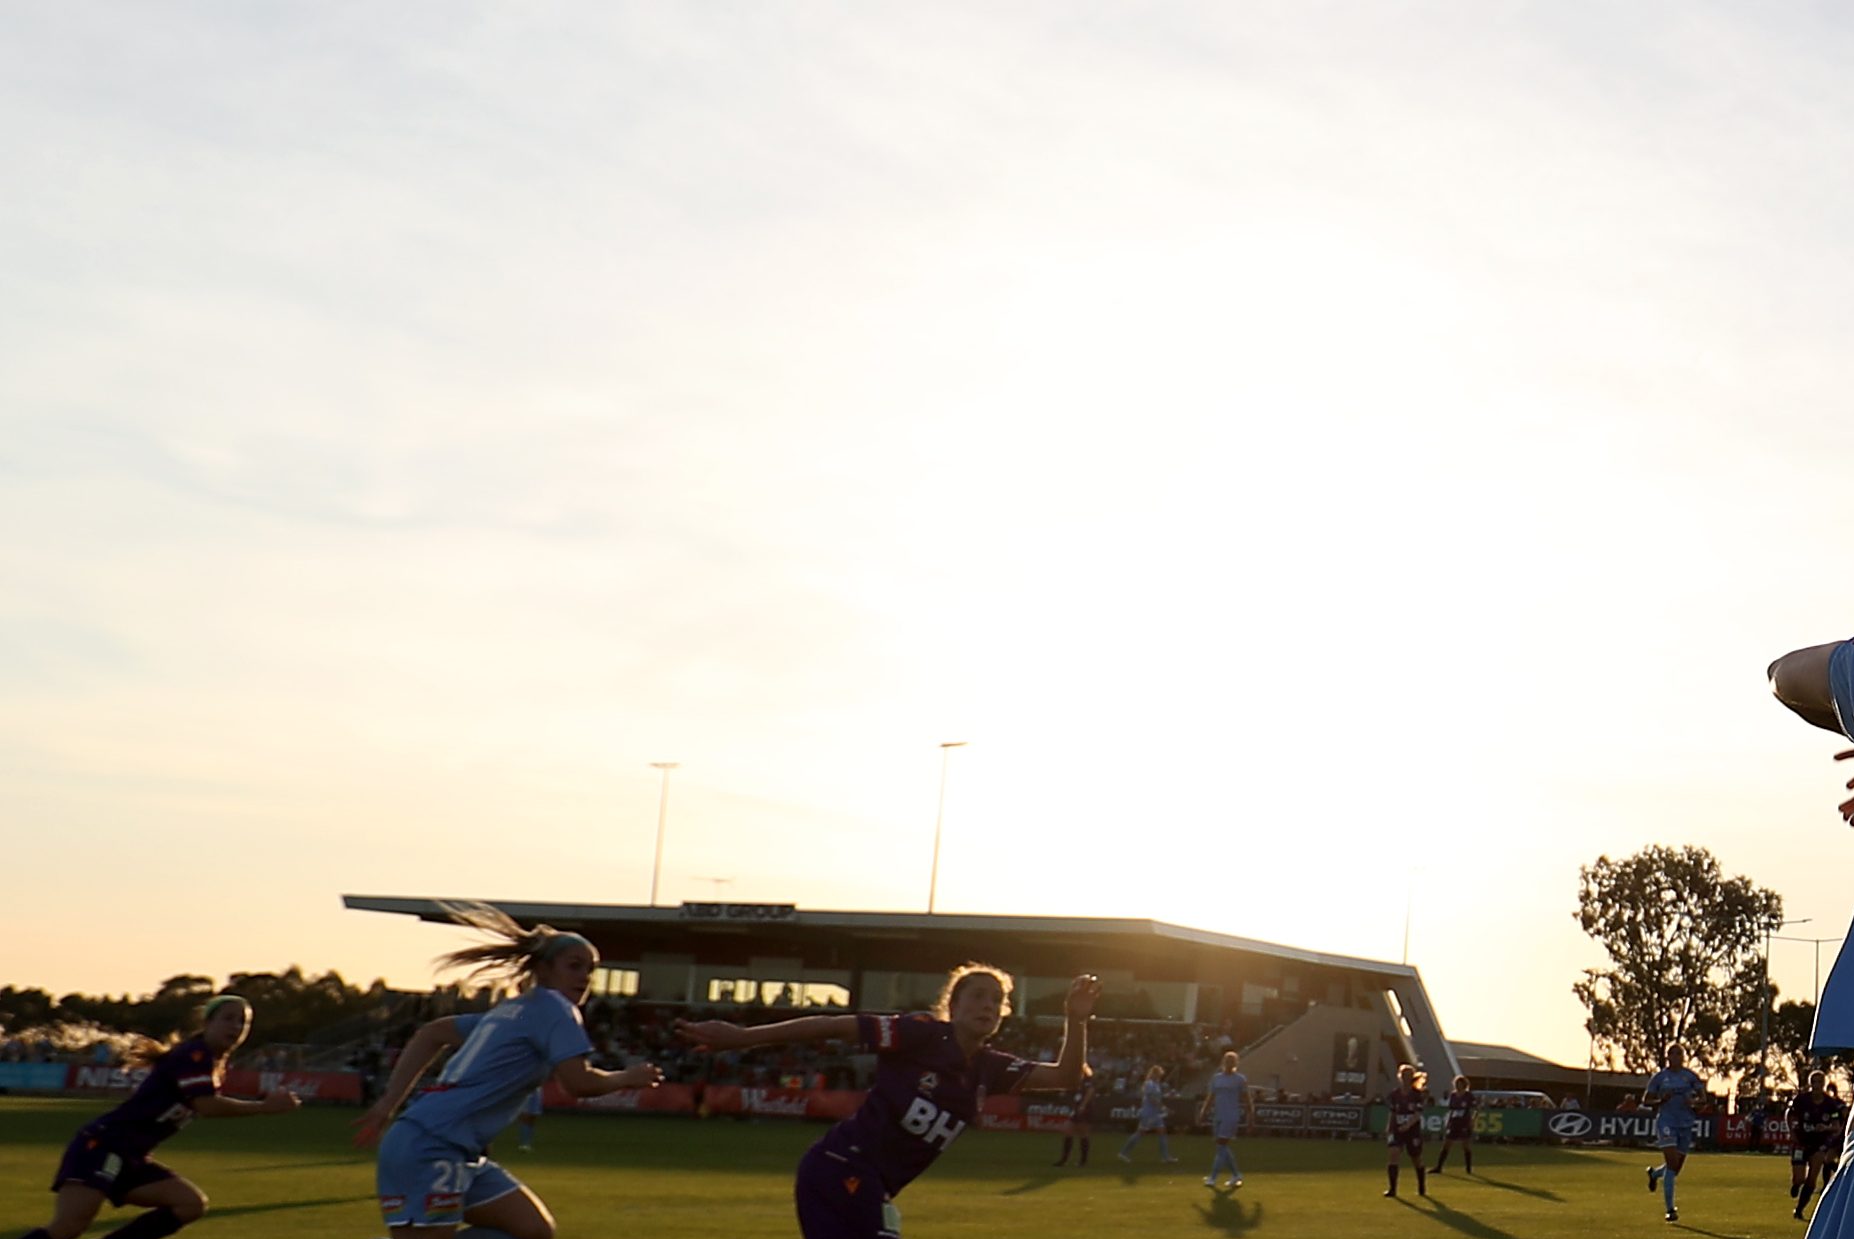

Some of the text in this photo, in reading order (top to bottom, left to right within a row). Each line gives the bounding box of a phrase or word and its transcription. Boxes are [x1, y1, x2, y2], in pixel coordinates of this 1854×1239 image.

[75, 1066, 152, 1090] NISS
[900, 1096, 967, 1152] BH
[1600, 1117, 1711, 1138] HYUAI
